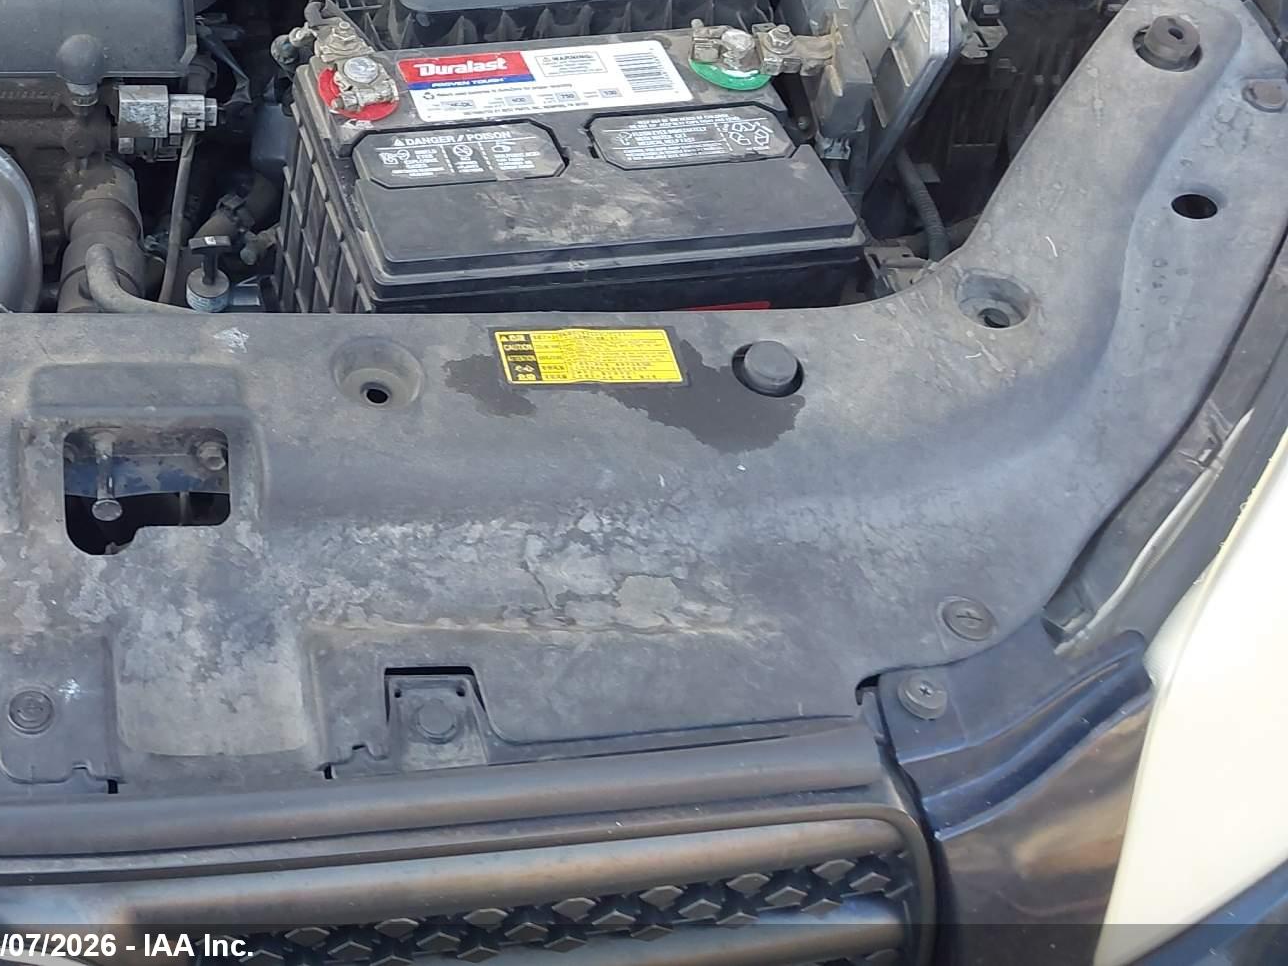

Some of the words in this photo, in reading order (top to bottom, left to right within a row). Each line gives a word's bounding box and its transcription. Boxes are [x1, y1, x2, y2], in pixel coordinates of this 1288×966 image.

[413, 57, 508, 77] Duralast
[405, 135, 456, 146] DANGER
[457, 134, 465, 143] /
[466, 131, 512, 141] POISON
